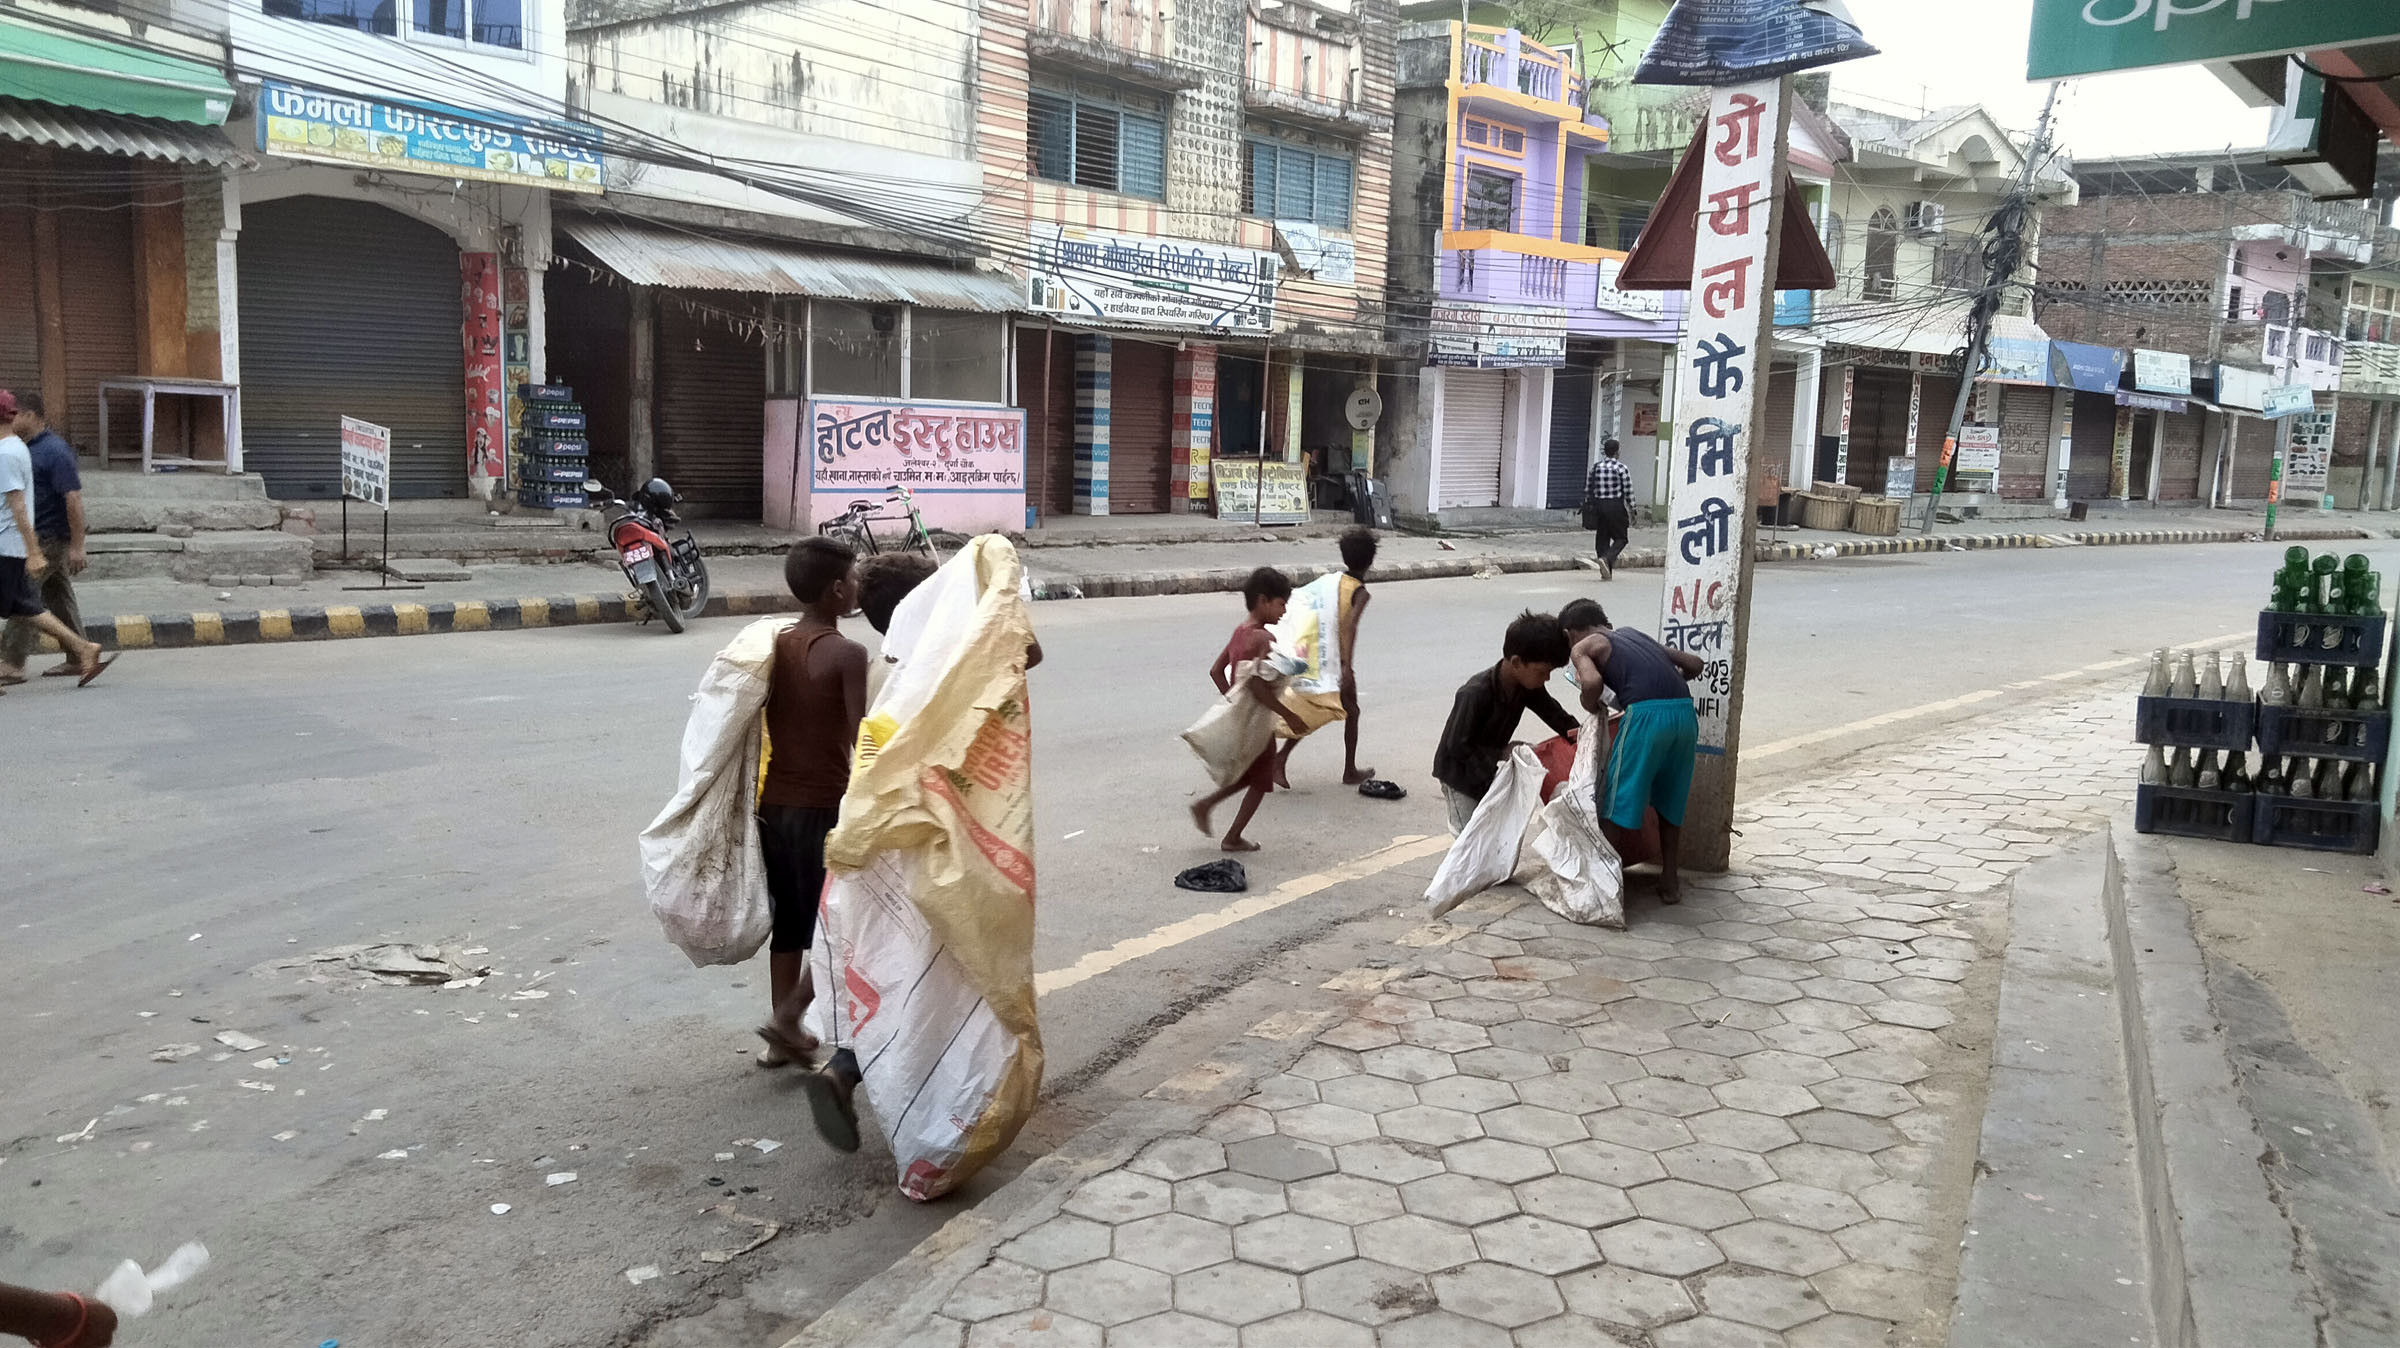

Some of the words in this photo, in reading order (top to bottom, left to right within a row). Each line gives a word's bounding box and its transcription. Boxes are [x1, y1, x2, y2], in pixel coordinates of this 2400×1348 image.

[545, 388, 566, 397] pepsi
[1094, 413, 1110, 422] vivo
[817, 409, 892, 465] होटल
[955, 416, 1021, 452] हाउस
[562, 442, 583, 452] pepsi
[1094, 449, 1109, 458] vivo
[1093, 485, 1108, 493] vivo
[1671, 579, 1723, 617] A/C
[974, 729, 1027, 791] UREA
